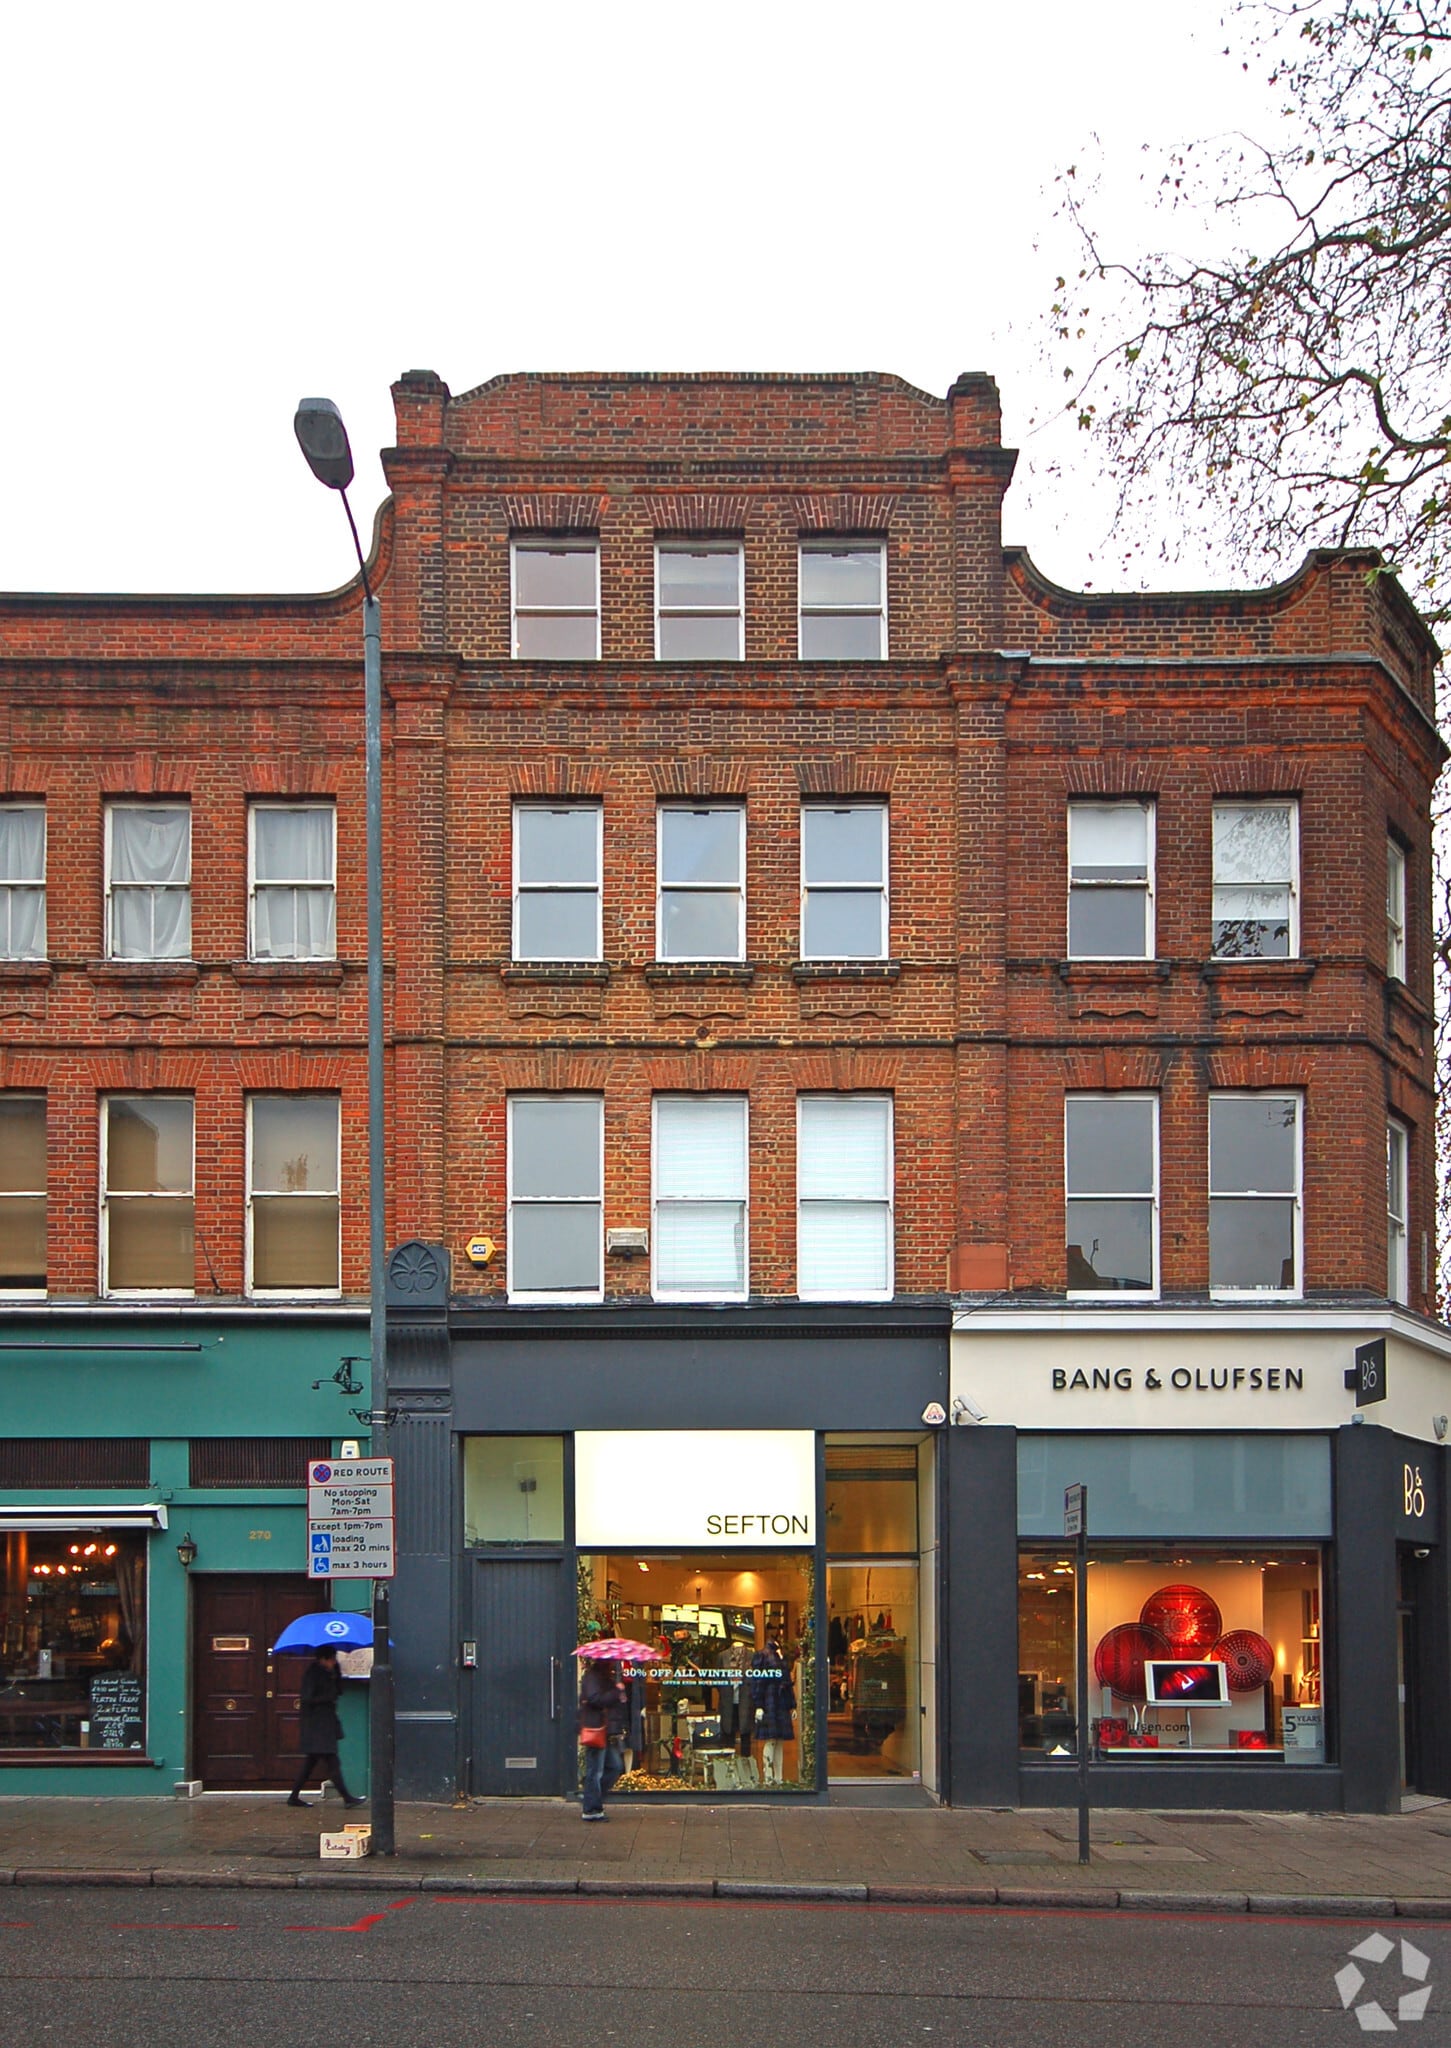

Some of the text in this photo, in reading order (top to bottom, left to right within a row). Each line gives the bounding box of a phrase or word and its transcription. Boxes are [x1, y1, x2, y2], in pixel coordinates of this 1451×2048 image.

[1052, 1368, 1303, 1390] BANG & OLUFSEN
[333, 1467, 389, 1477] RED ROUTE
[324, 1488, 377, 1497] No stopping
[332, 1498, 370, 1506] Mon-Sat
[330, 1507, 371, 1515] 7am-7pm
[311, 1521, 383, 1531] Except 1pm-7pm
[707, 1515, 808, 1534] SEFTON
[332, 1535, 365, 1543] loading
[353, 1544, 366, 1552] 20
[369, 1543, 390, 1552] mins
[353, 1561, 359, 1569] 3
[362, 1560, 388, 1569] hours
[623, 1668, 783, 1678] 30% OFF ALL WINTER COATS
[1285, 1715, 1296, 1733] 5
